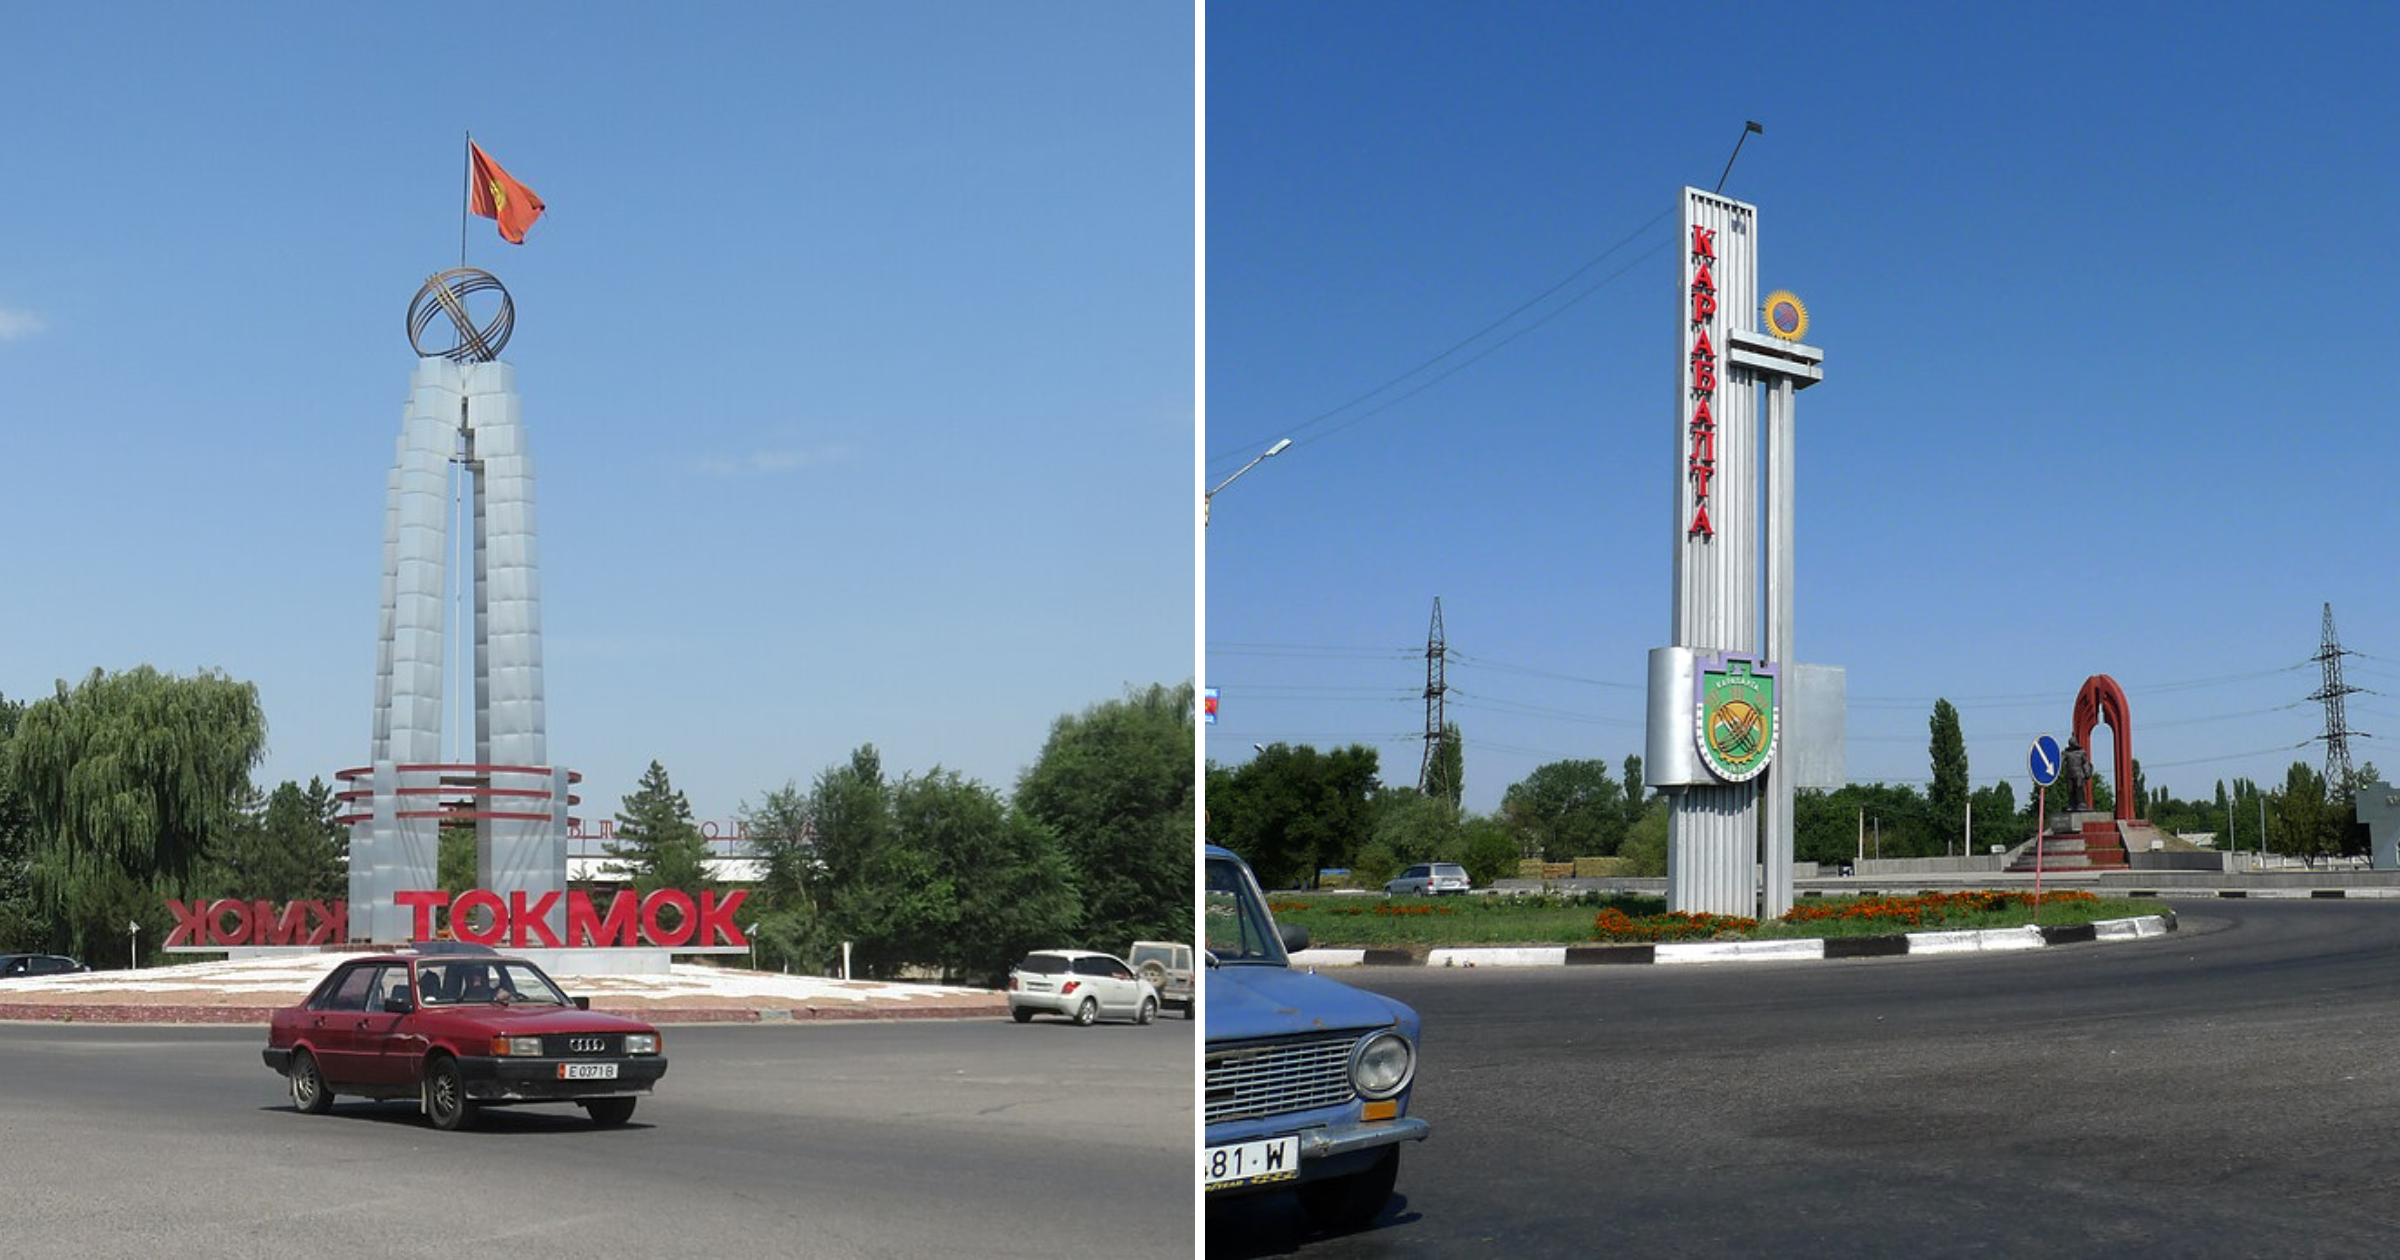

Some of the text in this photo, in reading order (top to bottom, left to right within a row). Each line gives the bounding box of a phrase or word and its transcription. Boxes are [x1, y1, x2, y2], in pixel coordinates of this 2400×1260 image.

[1690, 224, 1717, 535] КАРАБАЛТА
[394, 888, 750, 948] ТОКМОК
[1205, 1147, 1243, 1180] 81
[1266, 1141, 1285, 1171] W
